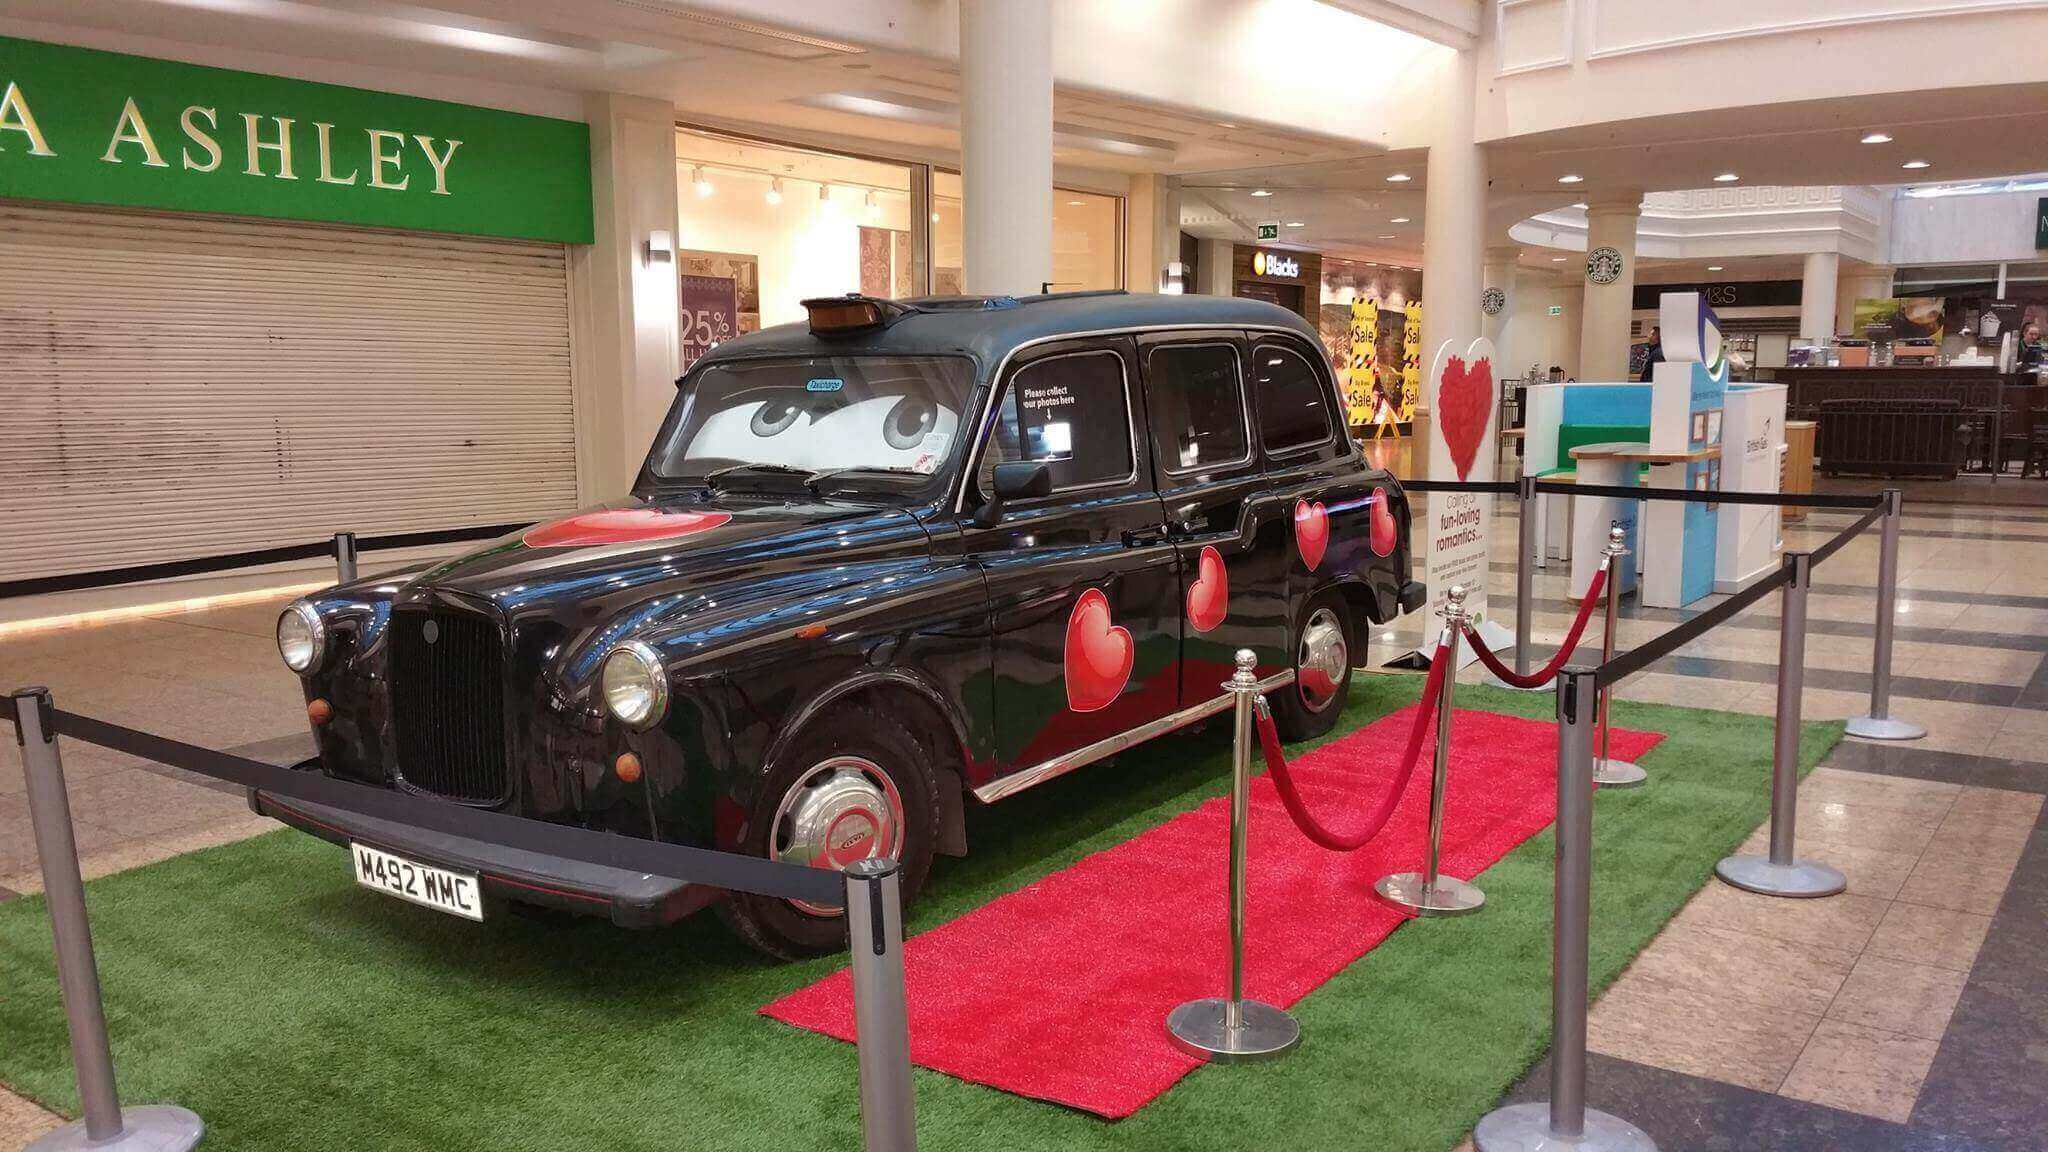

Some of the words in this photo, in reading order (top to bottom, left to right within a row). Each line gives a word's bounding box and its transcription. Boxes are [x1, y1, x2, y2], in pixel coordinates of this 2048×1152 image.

[100, 96, 464, 196] ASHLEY
[1266, 255, 1298, 278] Blacks
[1354, 325, 1374, 343] Sale
[1407, 327, 1420, 344] Sal
[1025, 389, 1046, 398] Please
[1047, 386, 1067, 396] collect
[1352, 389, 1372, 407] Sale
[1037, 398, 1059, 409] photos
[1060, 396, 1075, 405] here
[1441, 508, 1480, 531] fun-loving
[360, 850, 418, 896] M492
[422, 869, 471, 910] WMC
